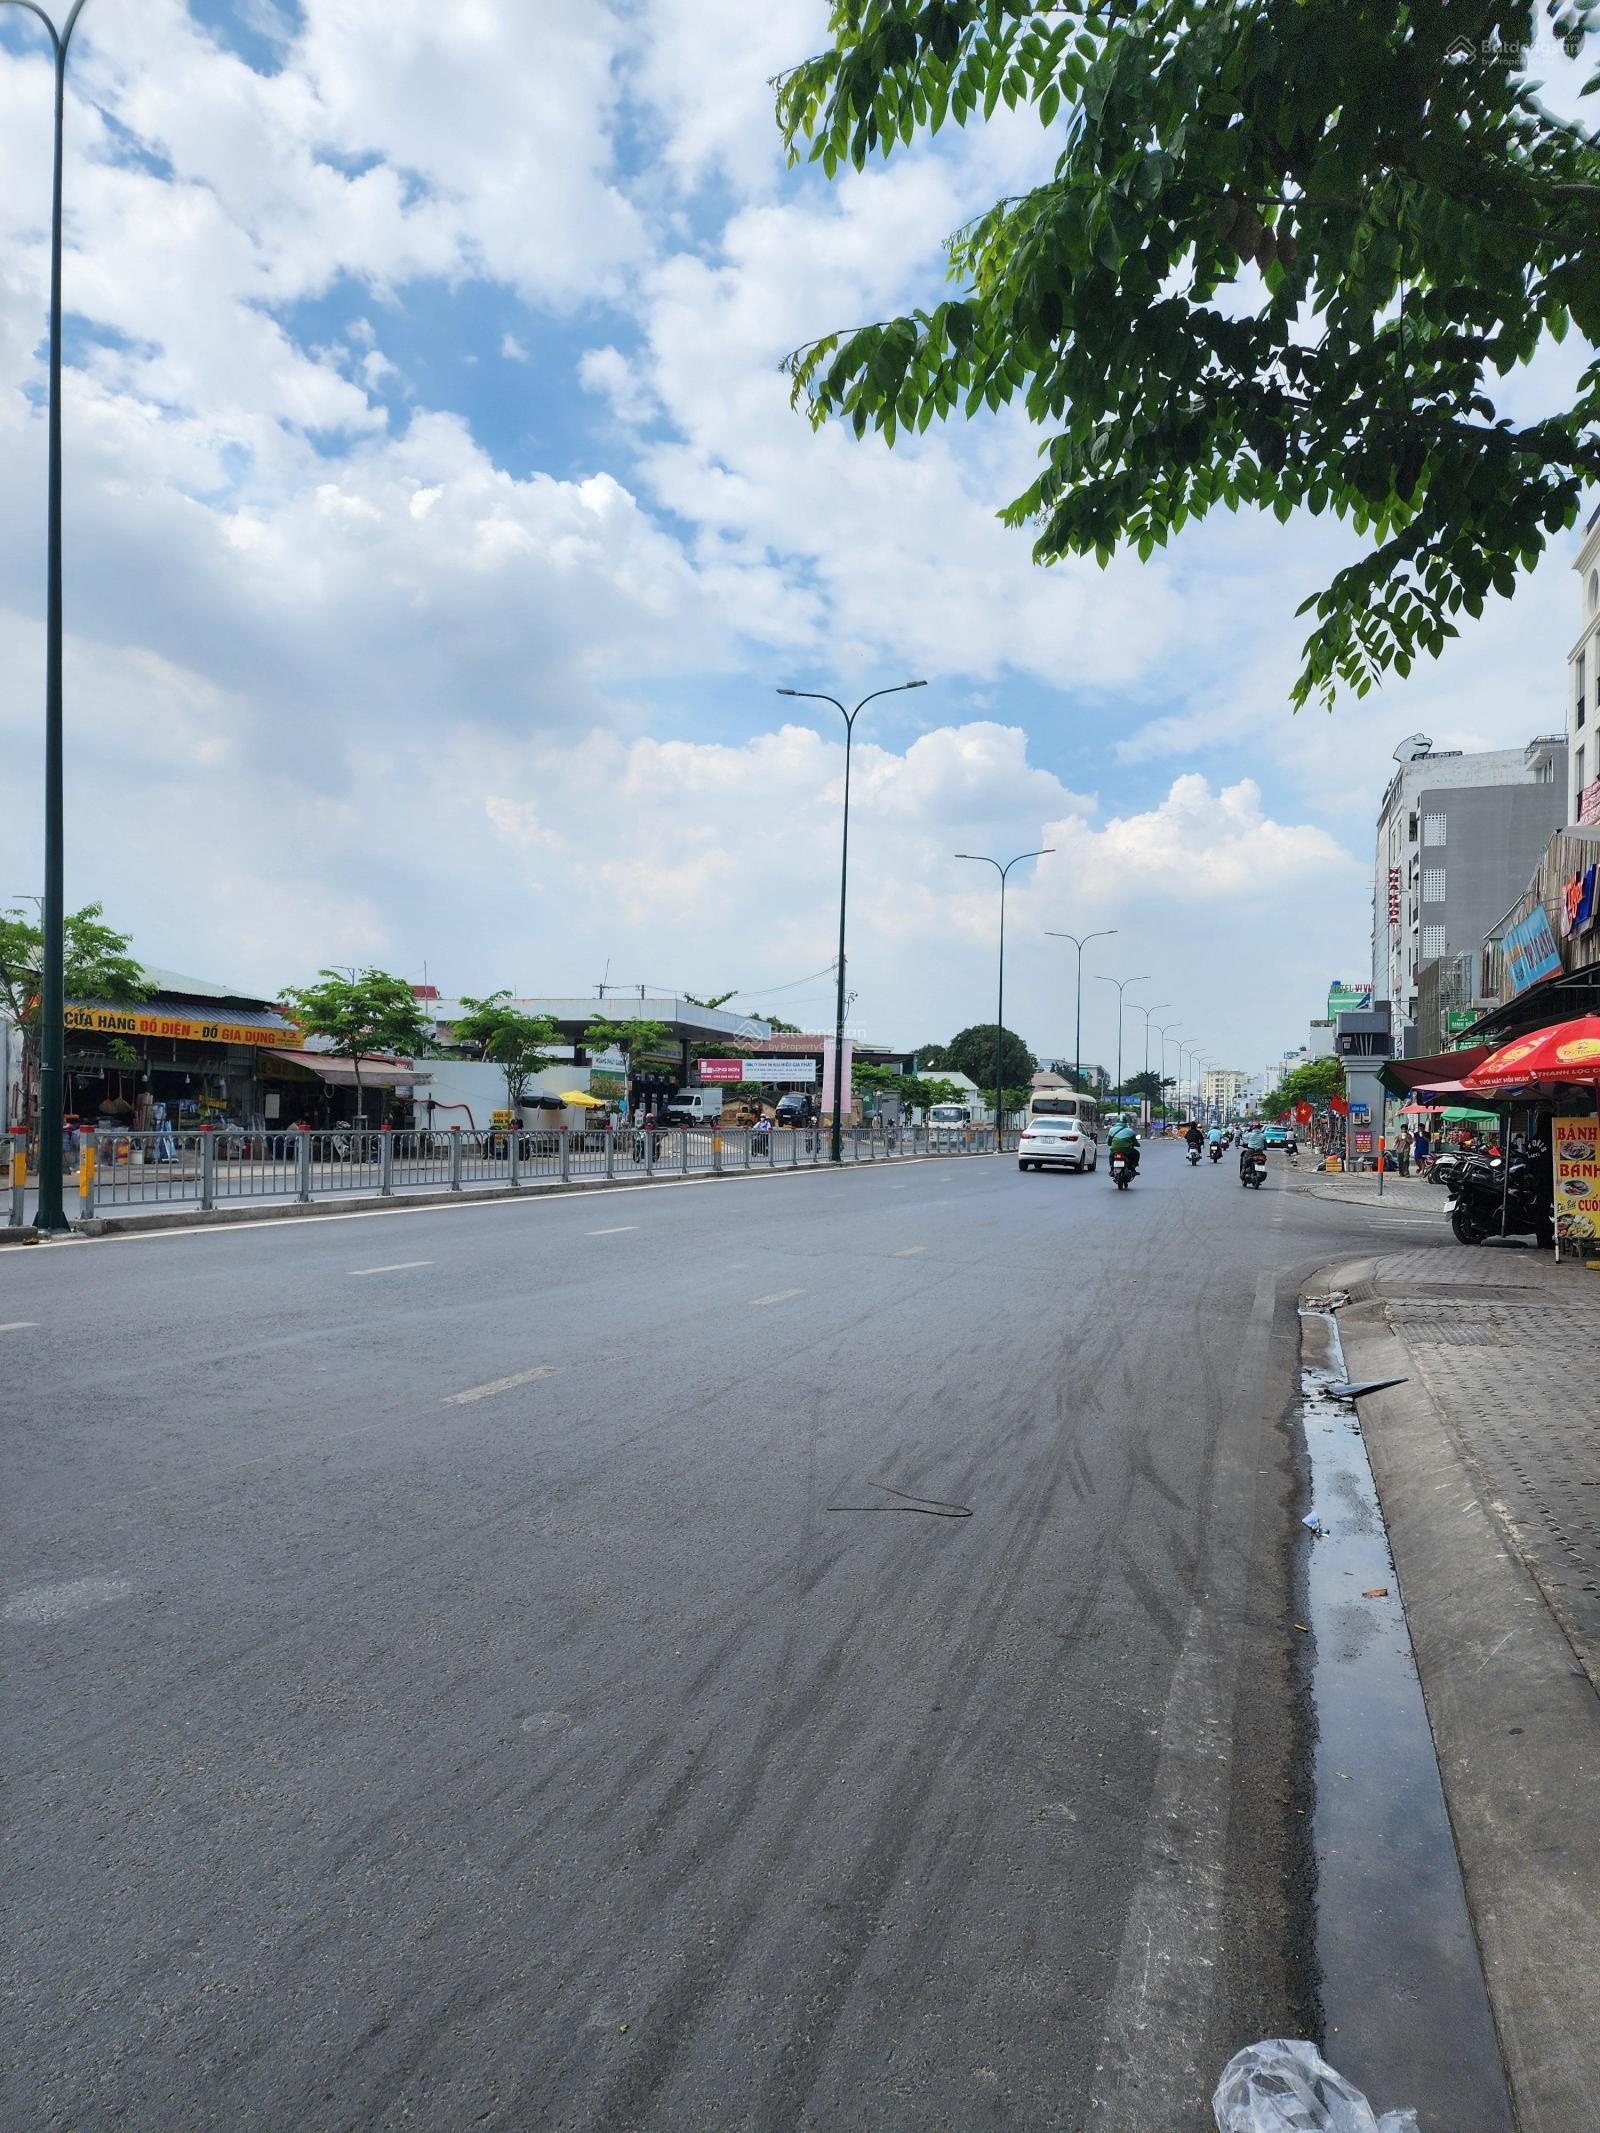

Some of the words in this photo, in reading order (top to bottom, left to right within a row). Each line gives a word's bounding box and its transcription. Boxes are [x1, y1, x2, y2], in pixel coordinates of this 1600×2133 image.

[98, 1014, 136, 1031] HÀNG
[222, 1028, 241, 1041] GIA
[1557, 1123, 1598, 1140] BÁNH
[1578, 1193, 1600, 1211] CUỐ
